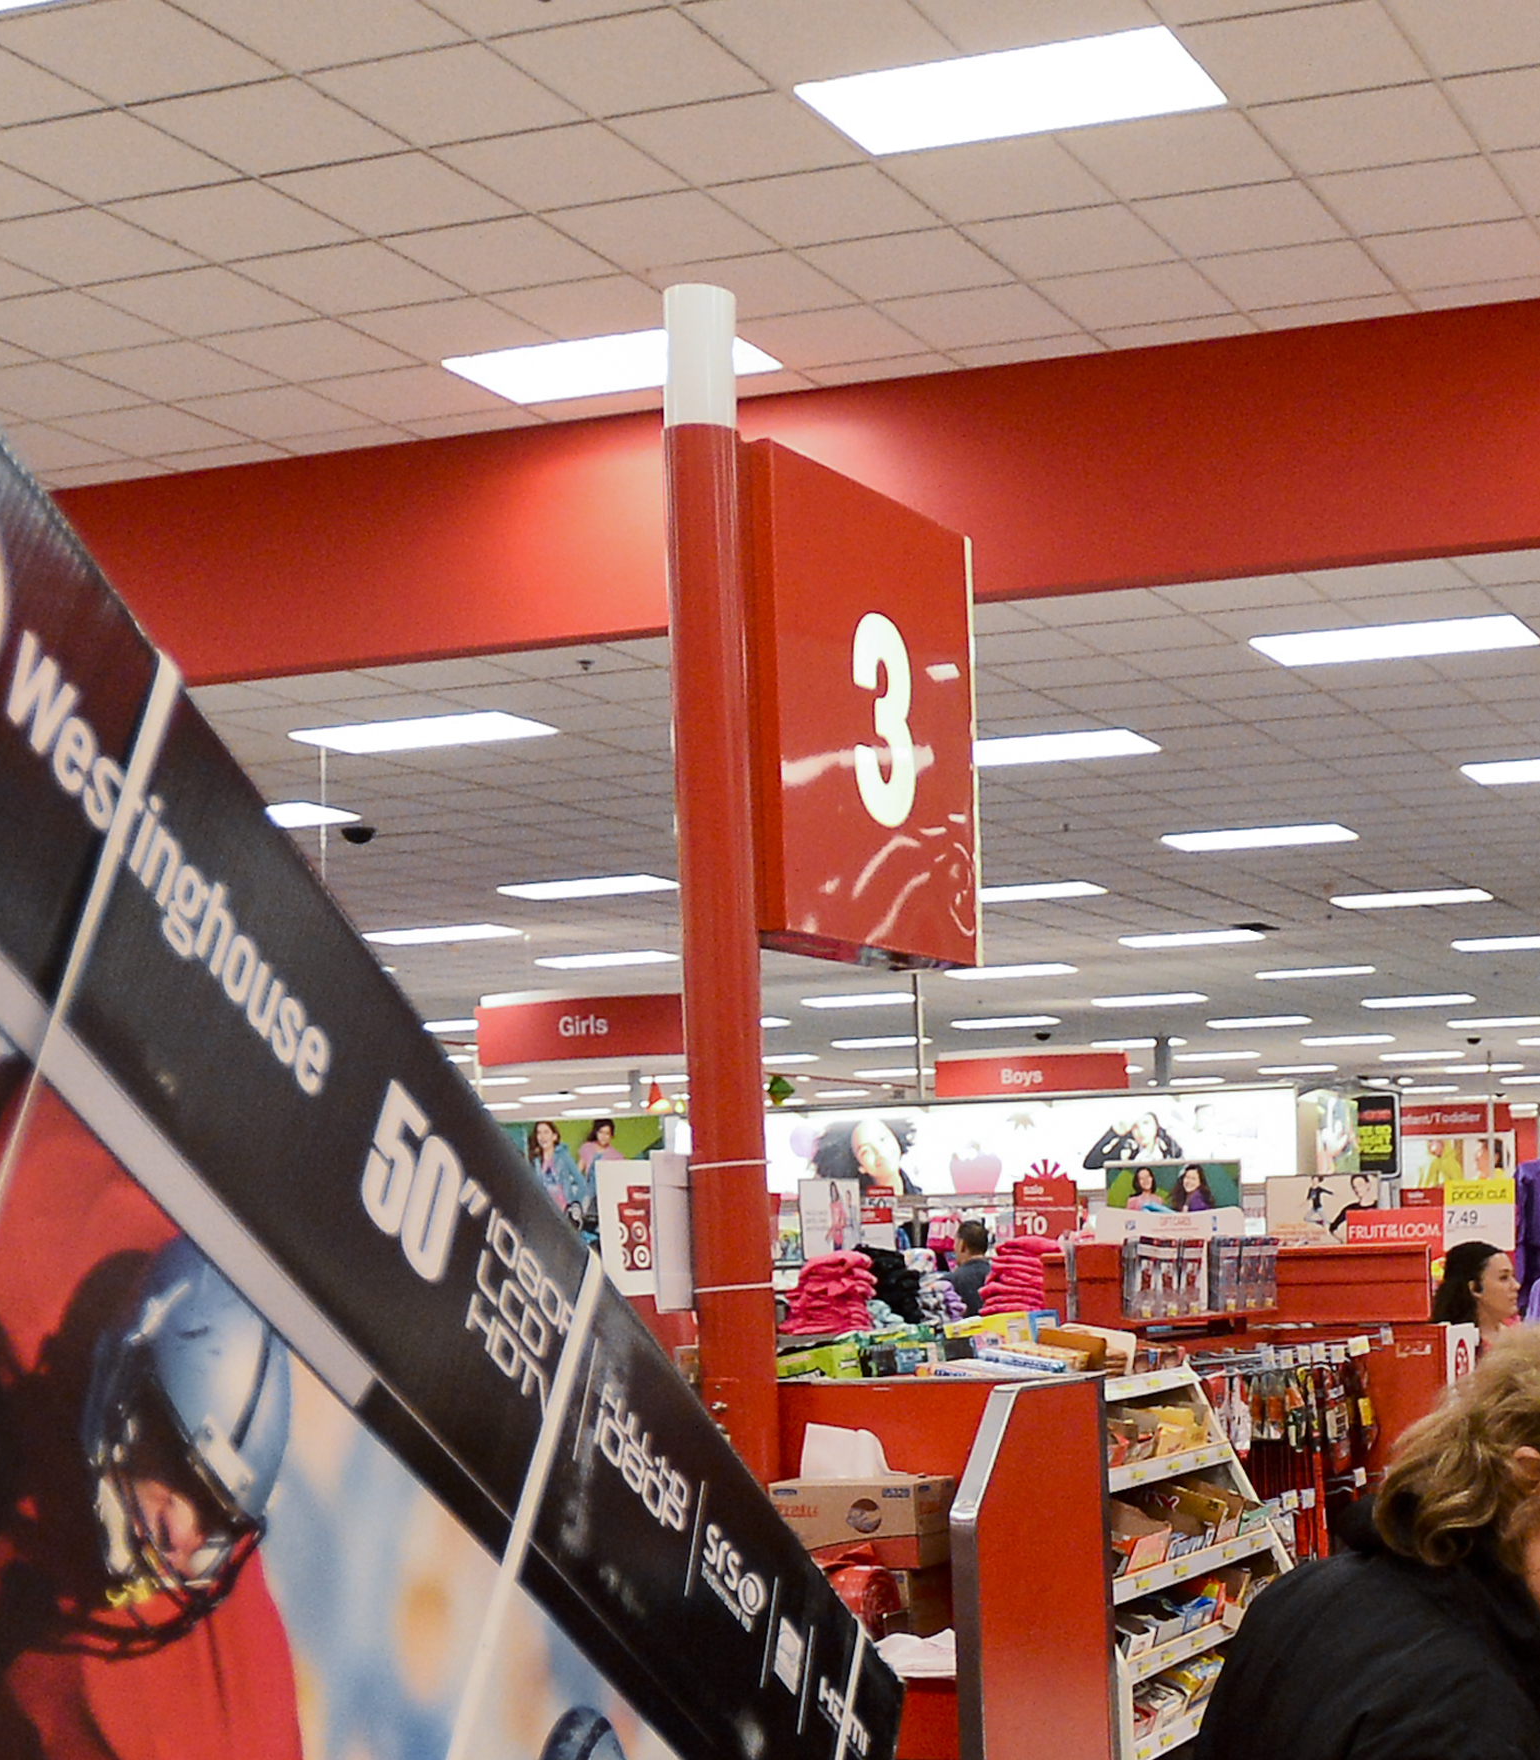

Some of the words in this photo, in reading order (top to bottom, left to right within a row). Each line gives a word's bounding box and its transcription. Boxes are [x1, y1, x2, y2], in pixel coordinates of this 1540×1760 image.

[852, 611, 917, 828] 3
[4, 629, 332, 1097] Wesinghouse
[558, 1014, 609, 1037] Girls
[1000, 1068, 1044, 1087] Boys
[1401, 1111, 1482, 1125] nfant/Toddler
[361, 1079, 490, 1284] 50"
[1451, 1187, 1483, 1202] price
[1487, 1188, 1508, 1200] cut
[1447, 1210, 1479, 1225] 7.49
[1348, 1224, 1387, 1240] FRUIT
[476, 1249, 550, 1359] LCD
[593, 1406, 686, 1532] 1080P
